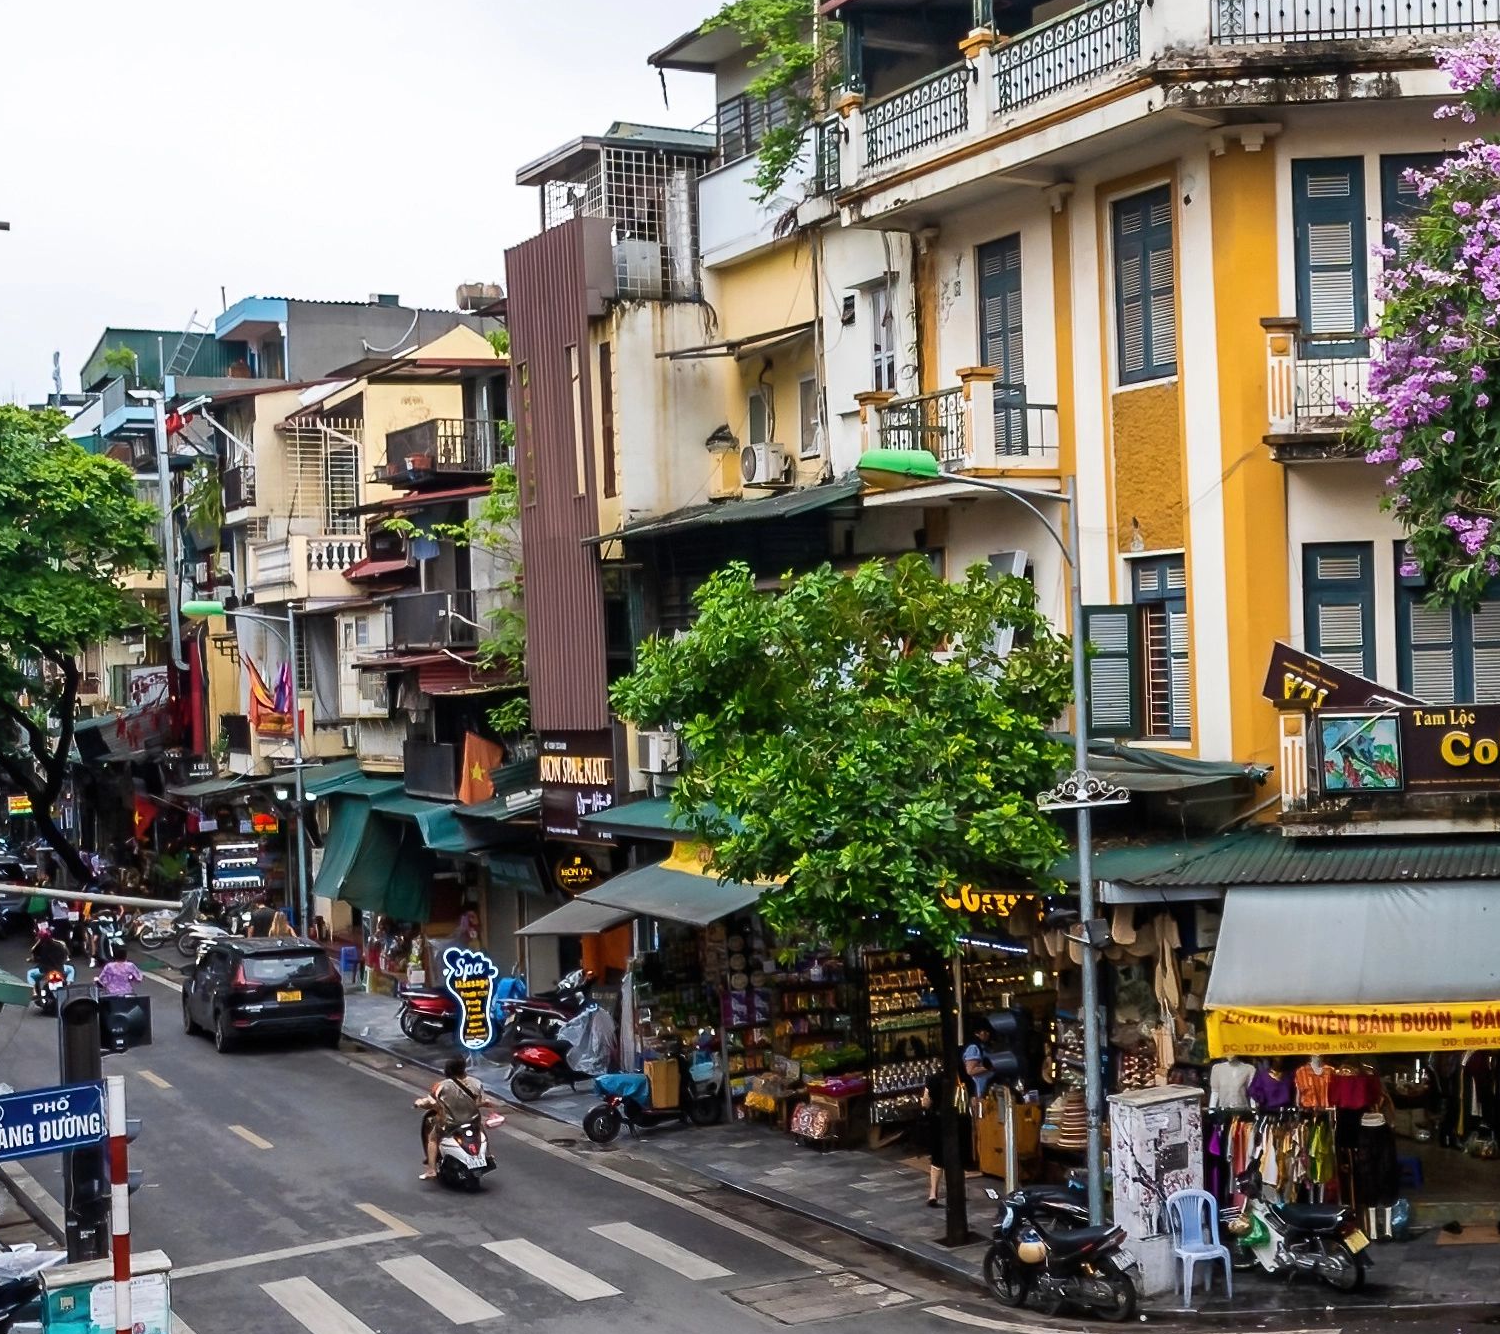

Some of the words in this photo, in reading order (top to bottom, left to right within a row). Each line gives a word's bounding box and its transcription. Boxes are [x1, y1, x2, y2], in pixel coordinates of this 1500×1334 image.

[1413, 711, 1446, 727] Tam
[1450, 708, 1476, 729] Lộc
[455, 957, 485, 982] Spa
[1277, 1010, 1350, 1036] CHUYÊN
[1357, 1009, 1395, 1035] BÁN
[1401, 1007, 1453, 1032] BUÔN
[32, 1095, 71, 1115] PHỐ
[39, 1111, 101, 1143] ĐƯỜNG
